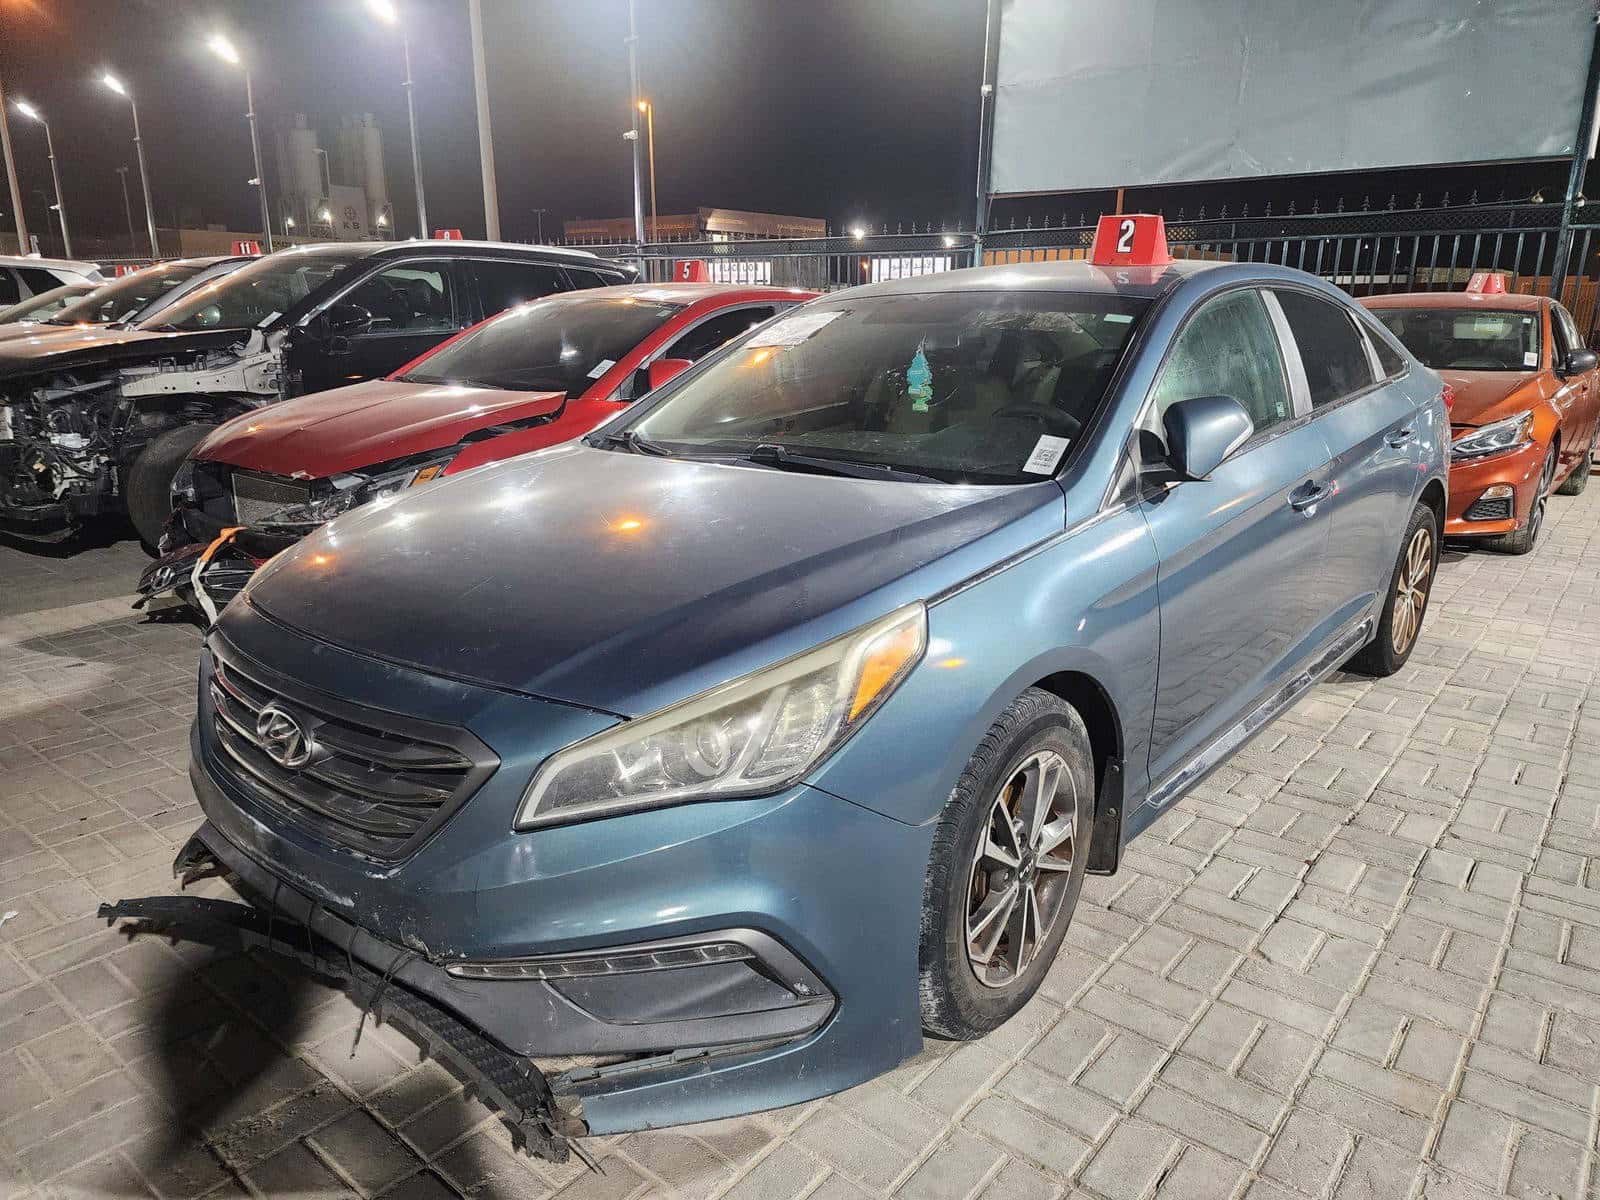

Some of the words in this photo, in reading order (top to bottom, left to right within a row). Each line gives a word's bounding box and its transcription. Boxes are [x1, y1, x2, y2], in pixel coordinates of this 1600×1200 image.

[1117, 219, 1135, 253] 2
[240, 242, 250, 255] 11
[682, 262, 690, 279] 5
